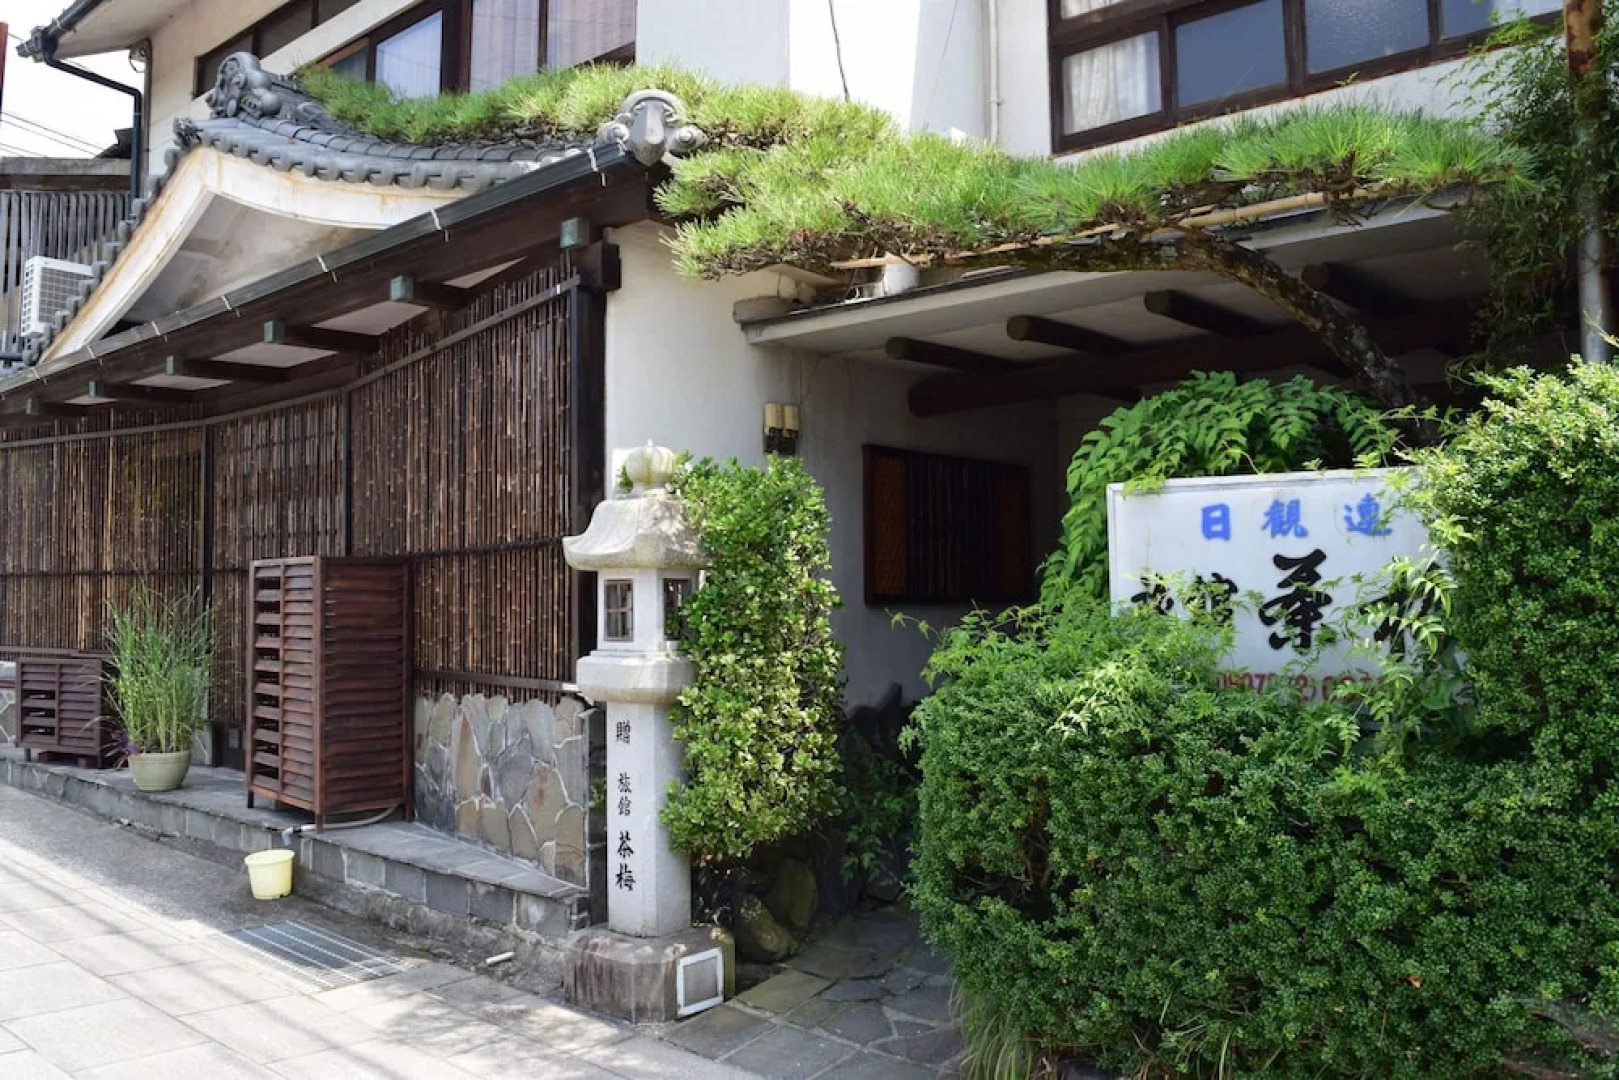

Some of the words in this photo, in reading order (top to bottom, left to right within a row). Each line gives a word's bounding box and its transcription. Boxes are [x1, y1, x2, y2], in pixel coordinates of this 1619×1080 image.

[1201, 493, 1394, 541] 日観連
[616, 771, 633, 817] 旅館
[615, 830, 637, 892] 茶梅
